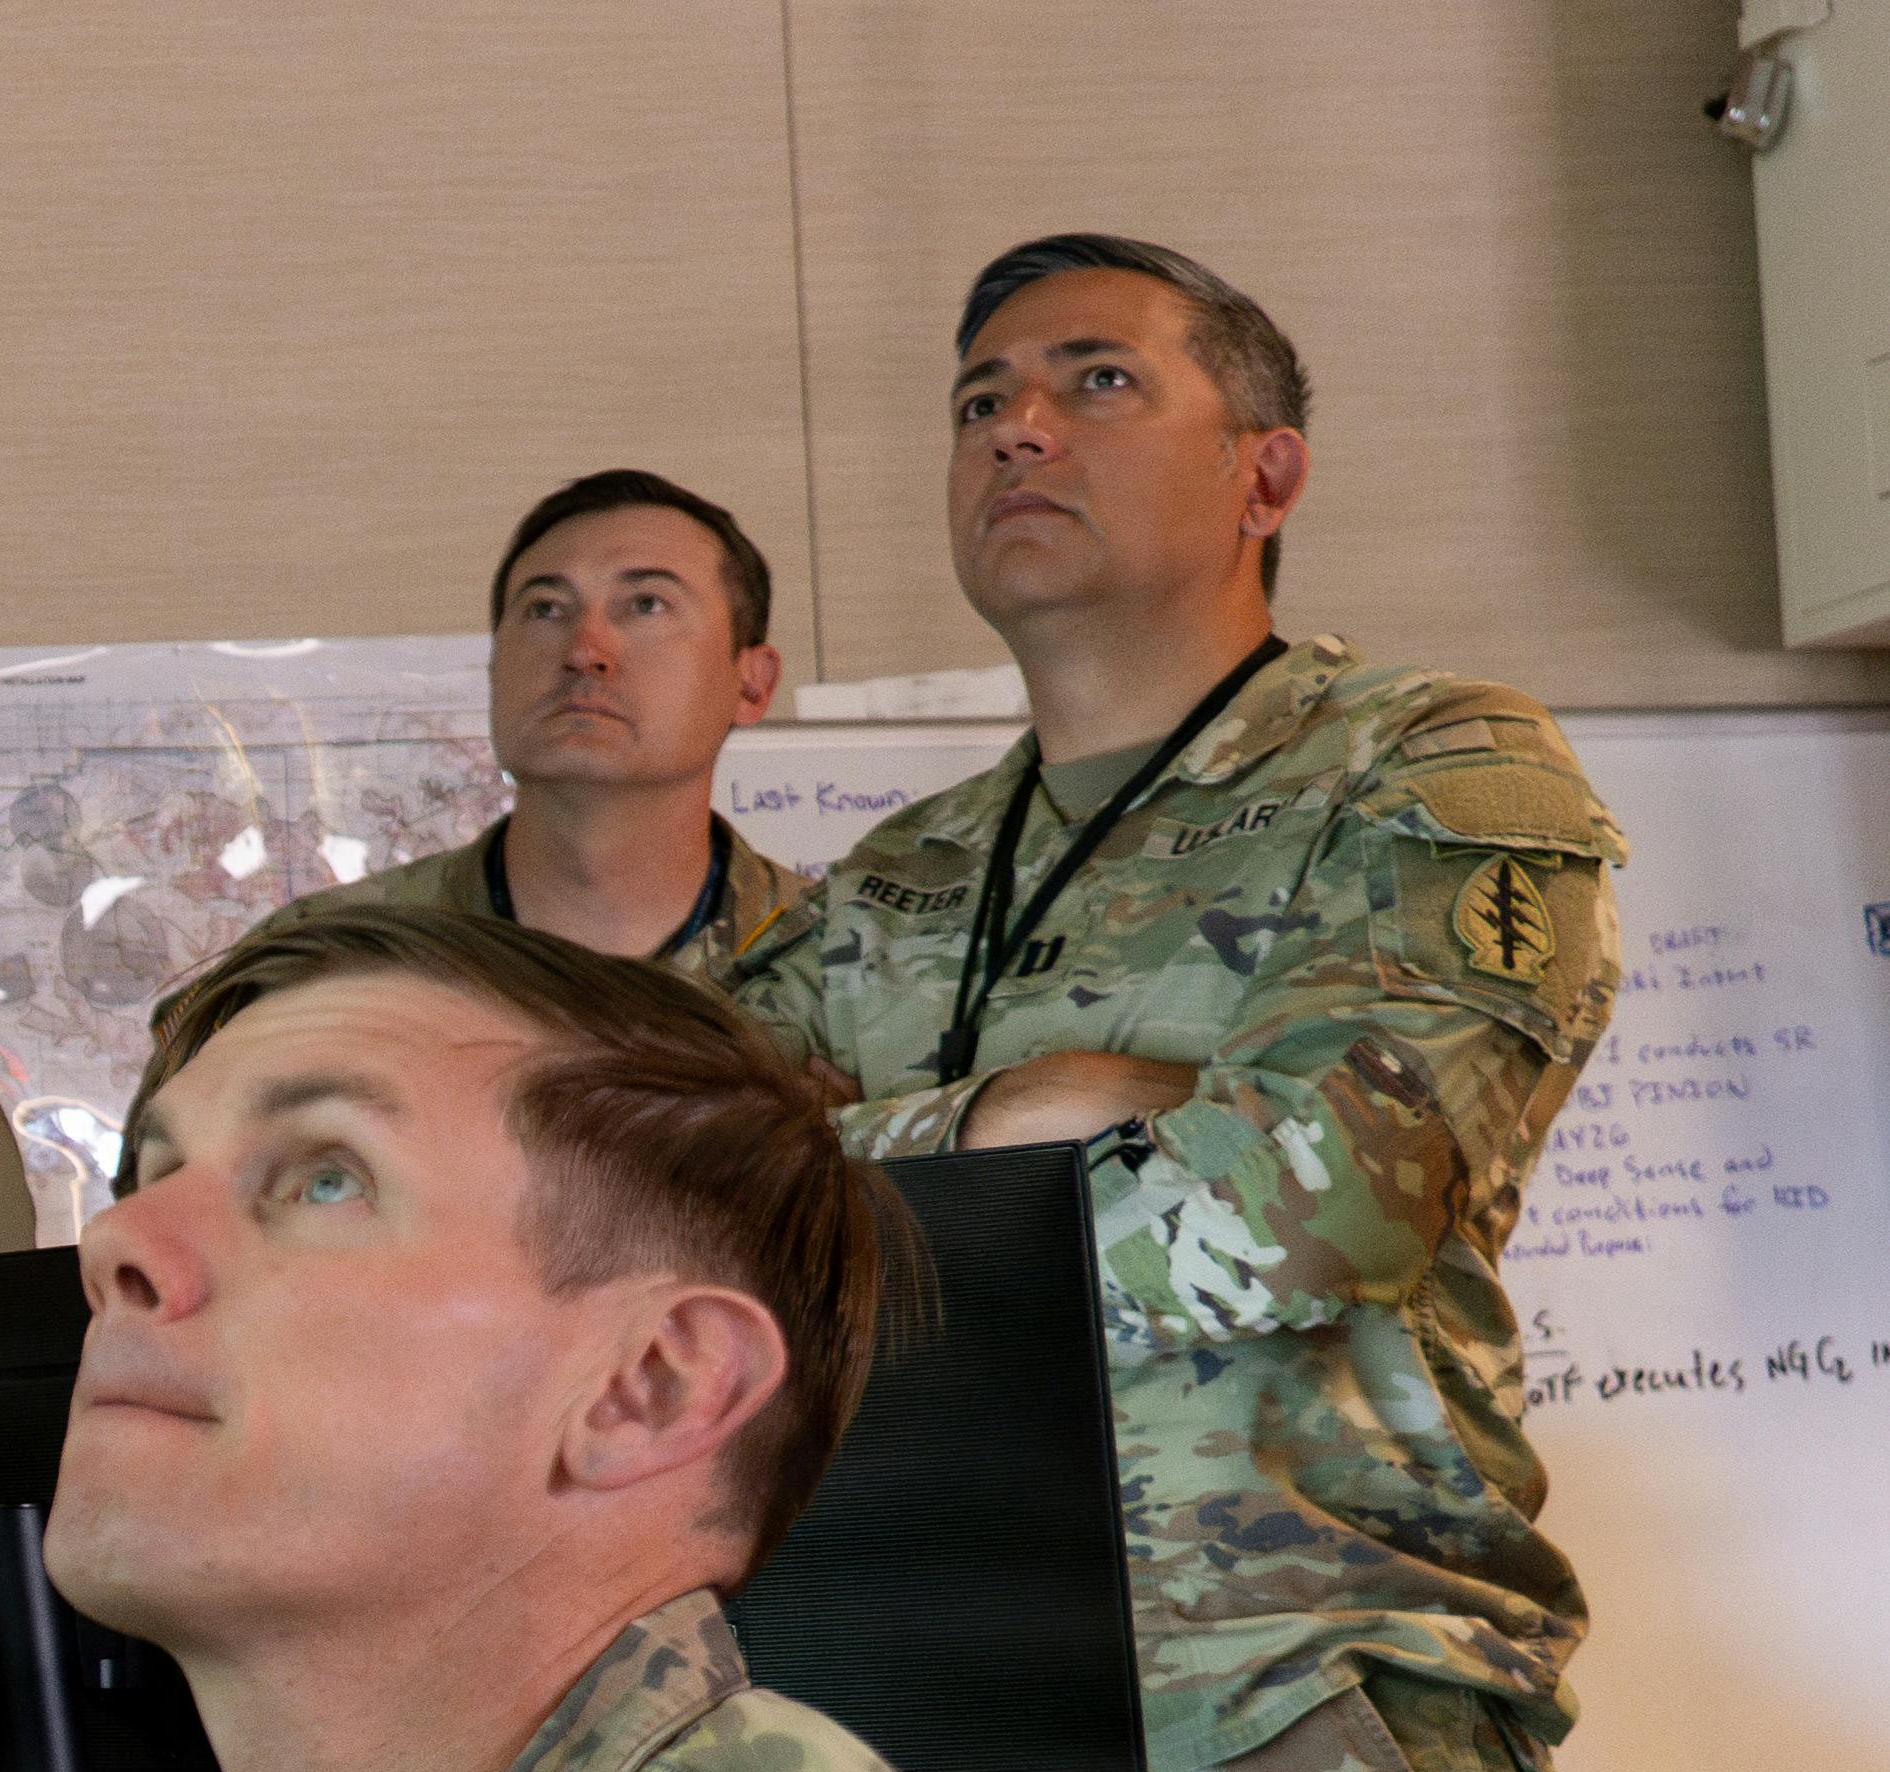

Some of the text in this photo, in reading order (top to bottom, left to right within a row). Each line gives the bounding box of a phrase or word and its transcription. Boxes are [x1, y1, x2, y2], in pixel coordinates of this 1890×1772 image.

[730, 779, 802, 815] Last
[1723, 1145, 1774, 1173] and
[1721, 1182, 1757, 1216] for
[1594, 1347, 1746, 1402] executes
